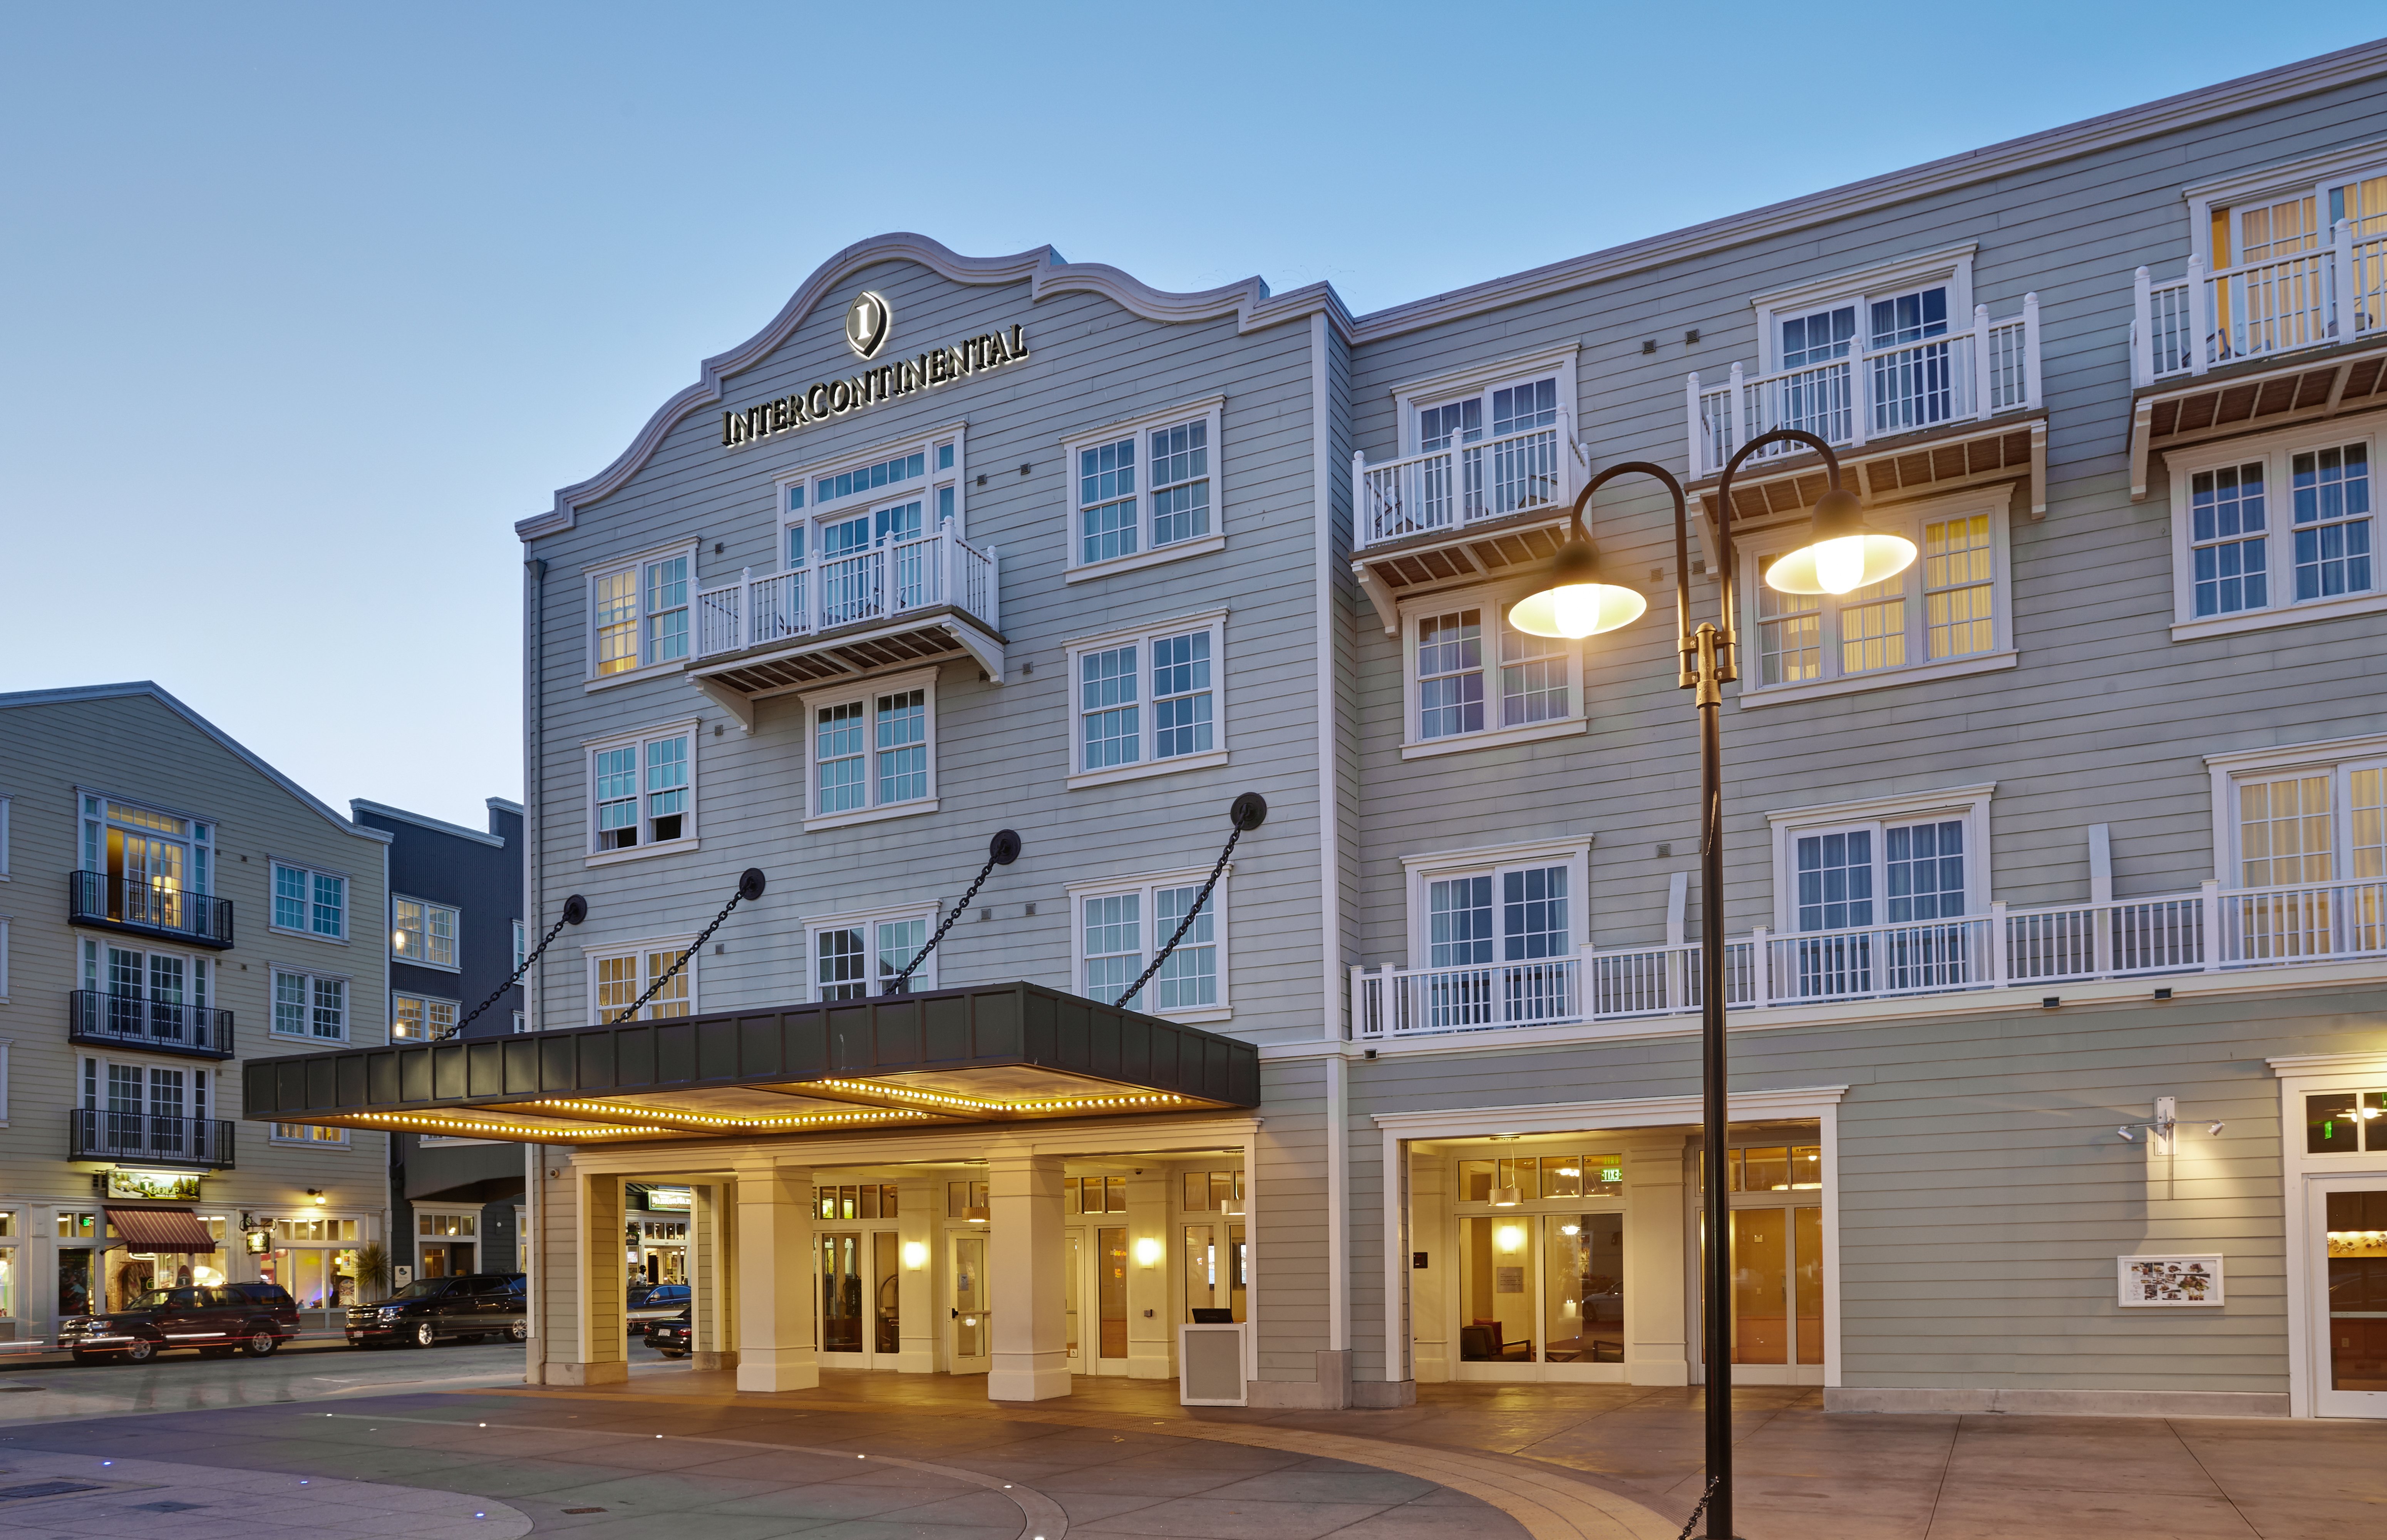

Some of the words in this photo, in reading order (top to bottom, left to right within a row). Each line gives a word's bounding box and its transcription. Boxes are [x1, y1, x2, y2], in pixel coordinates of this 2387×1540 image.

[721, 323, 1028, 447] INTERCONTINENTAL
[144, 1182, 149, 1190] 1
[148, 1186, 180, 1195] GOLF
